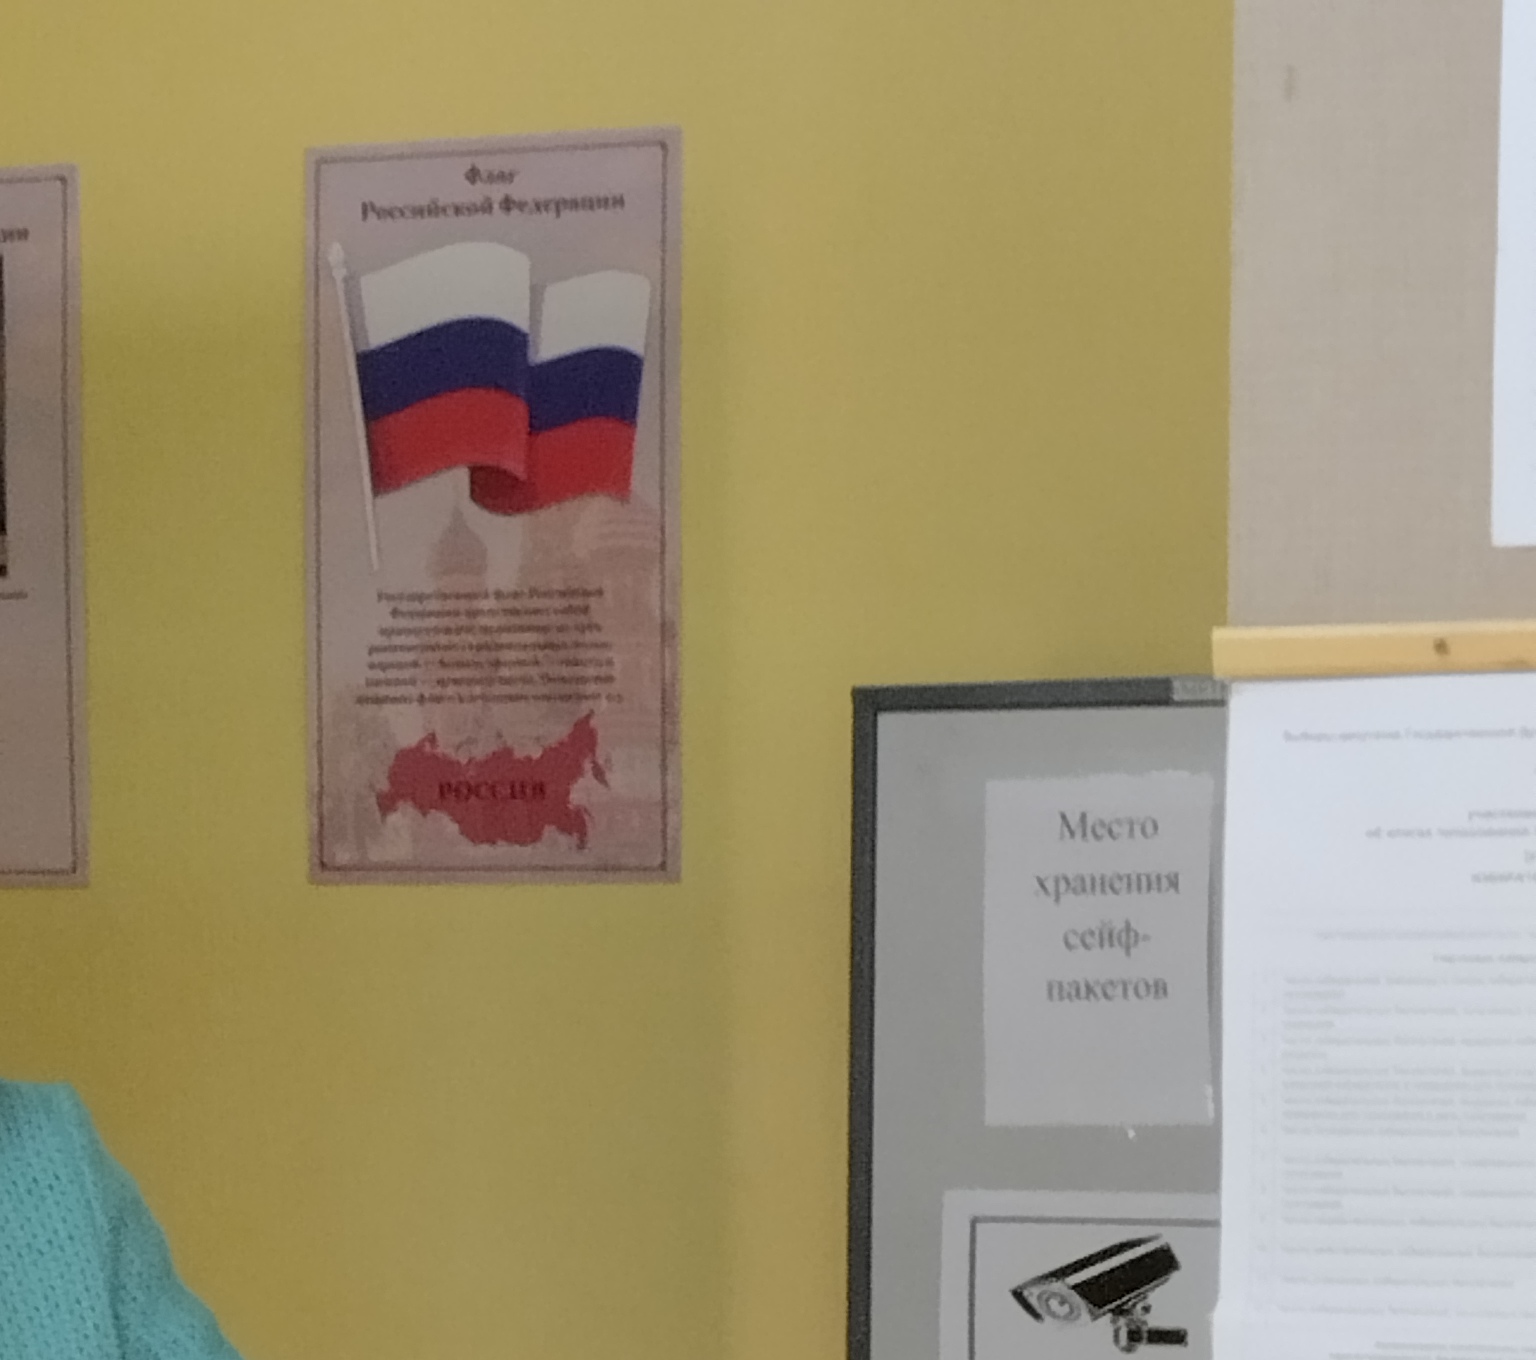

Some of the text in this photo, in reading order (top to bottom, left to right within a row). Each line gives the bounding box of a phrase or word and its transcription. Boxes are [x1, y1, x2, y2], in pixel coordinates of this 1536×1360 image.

[463, 163, 519, 187] Флаг
[360, 193, 626, 222] Российской Федерации
[438, 780, 546, 800] РОССИЯ
[1059, 810, 1160, 843] Место
[1032, 871, 1181, 906] хранения
[1063, 917, 1152, 958] сейф-
[1046, 977, 1169, 1003] пакетов
